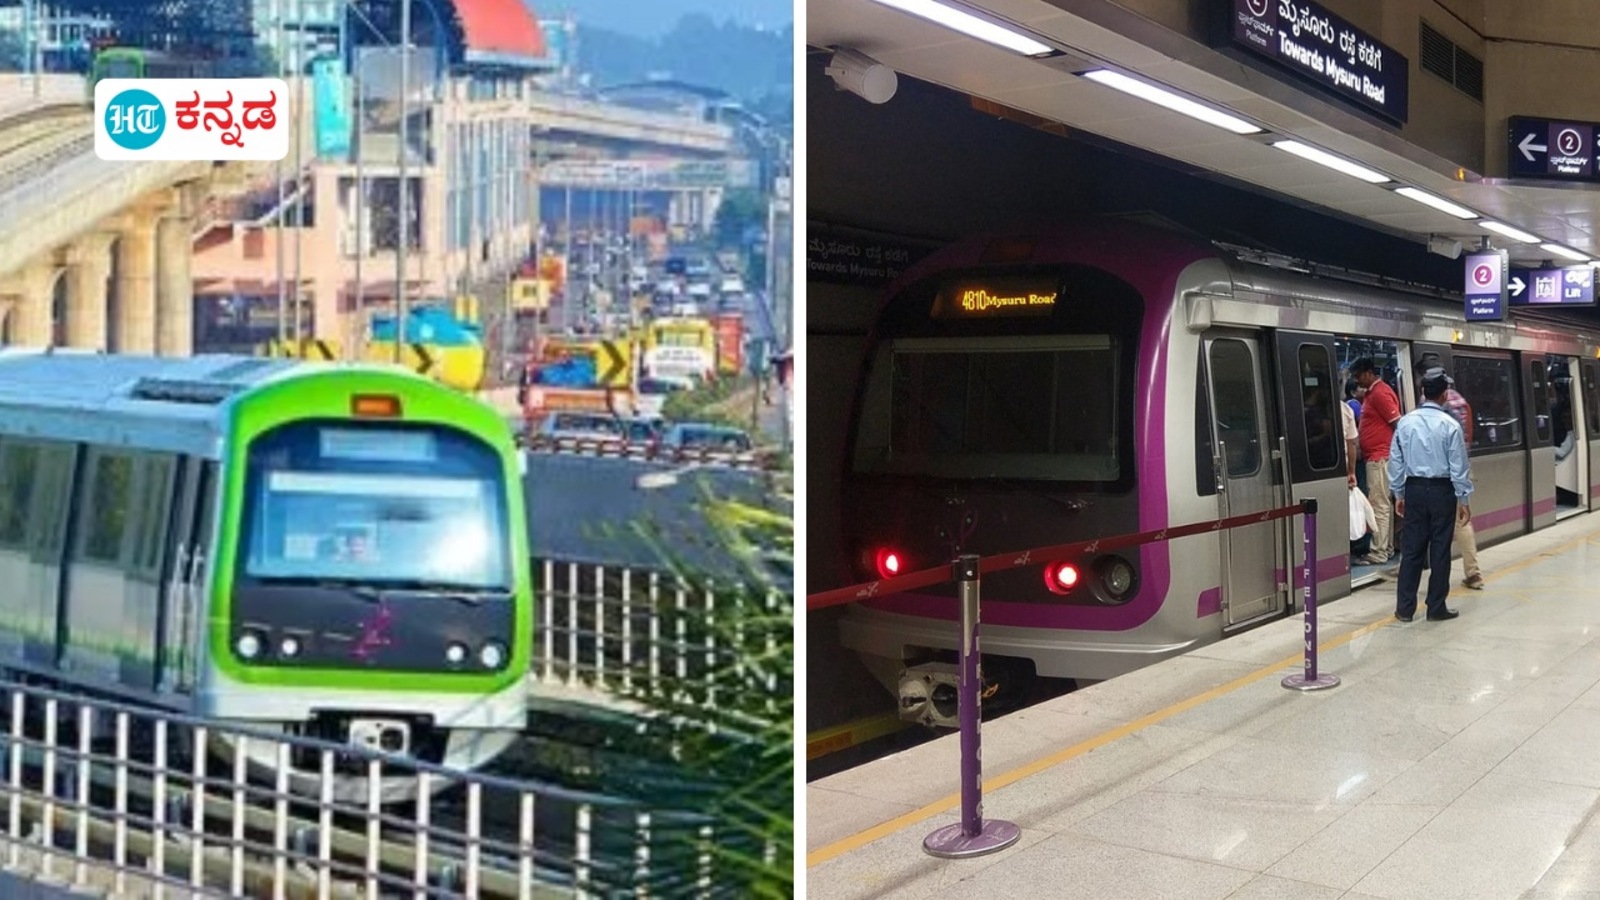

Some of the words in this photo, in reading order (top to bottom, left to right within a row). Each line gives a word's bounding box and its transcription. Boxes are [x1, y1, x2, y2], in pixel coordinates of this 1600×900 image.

[1278, 30, 1324, 73] Towards
[1326, 56, 1361, 92] Mysuru
[1362, 76, 1385, 105] Road
[1565, 135, 1575, 150] 2
[806, 258, 848, 273] Towards
[850, 263, 885, 278] Mysuru
[1479, 269, 1488, 282] 2
[962, 290, 987, 310] 4810
[987, 295, 1027, 308] Mysuru
[1565, 288, 1581, 298] Lift
[1303, 532, 1312, 669] LIFELONG
